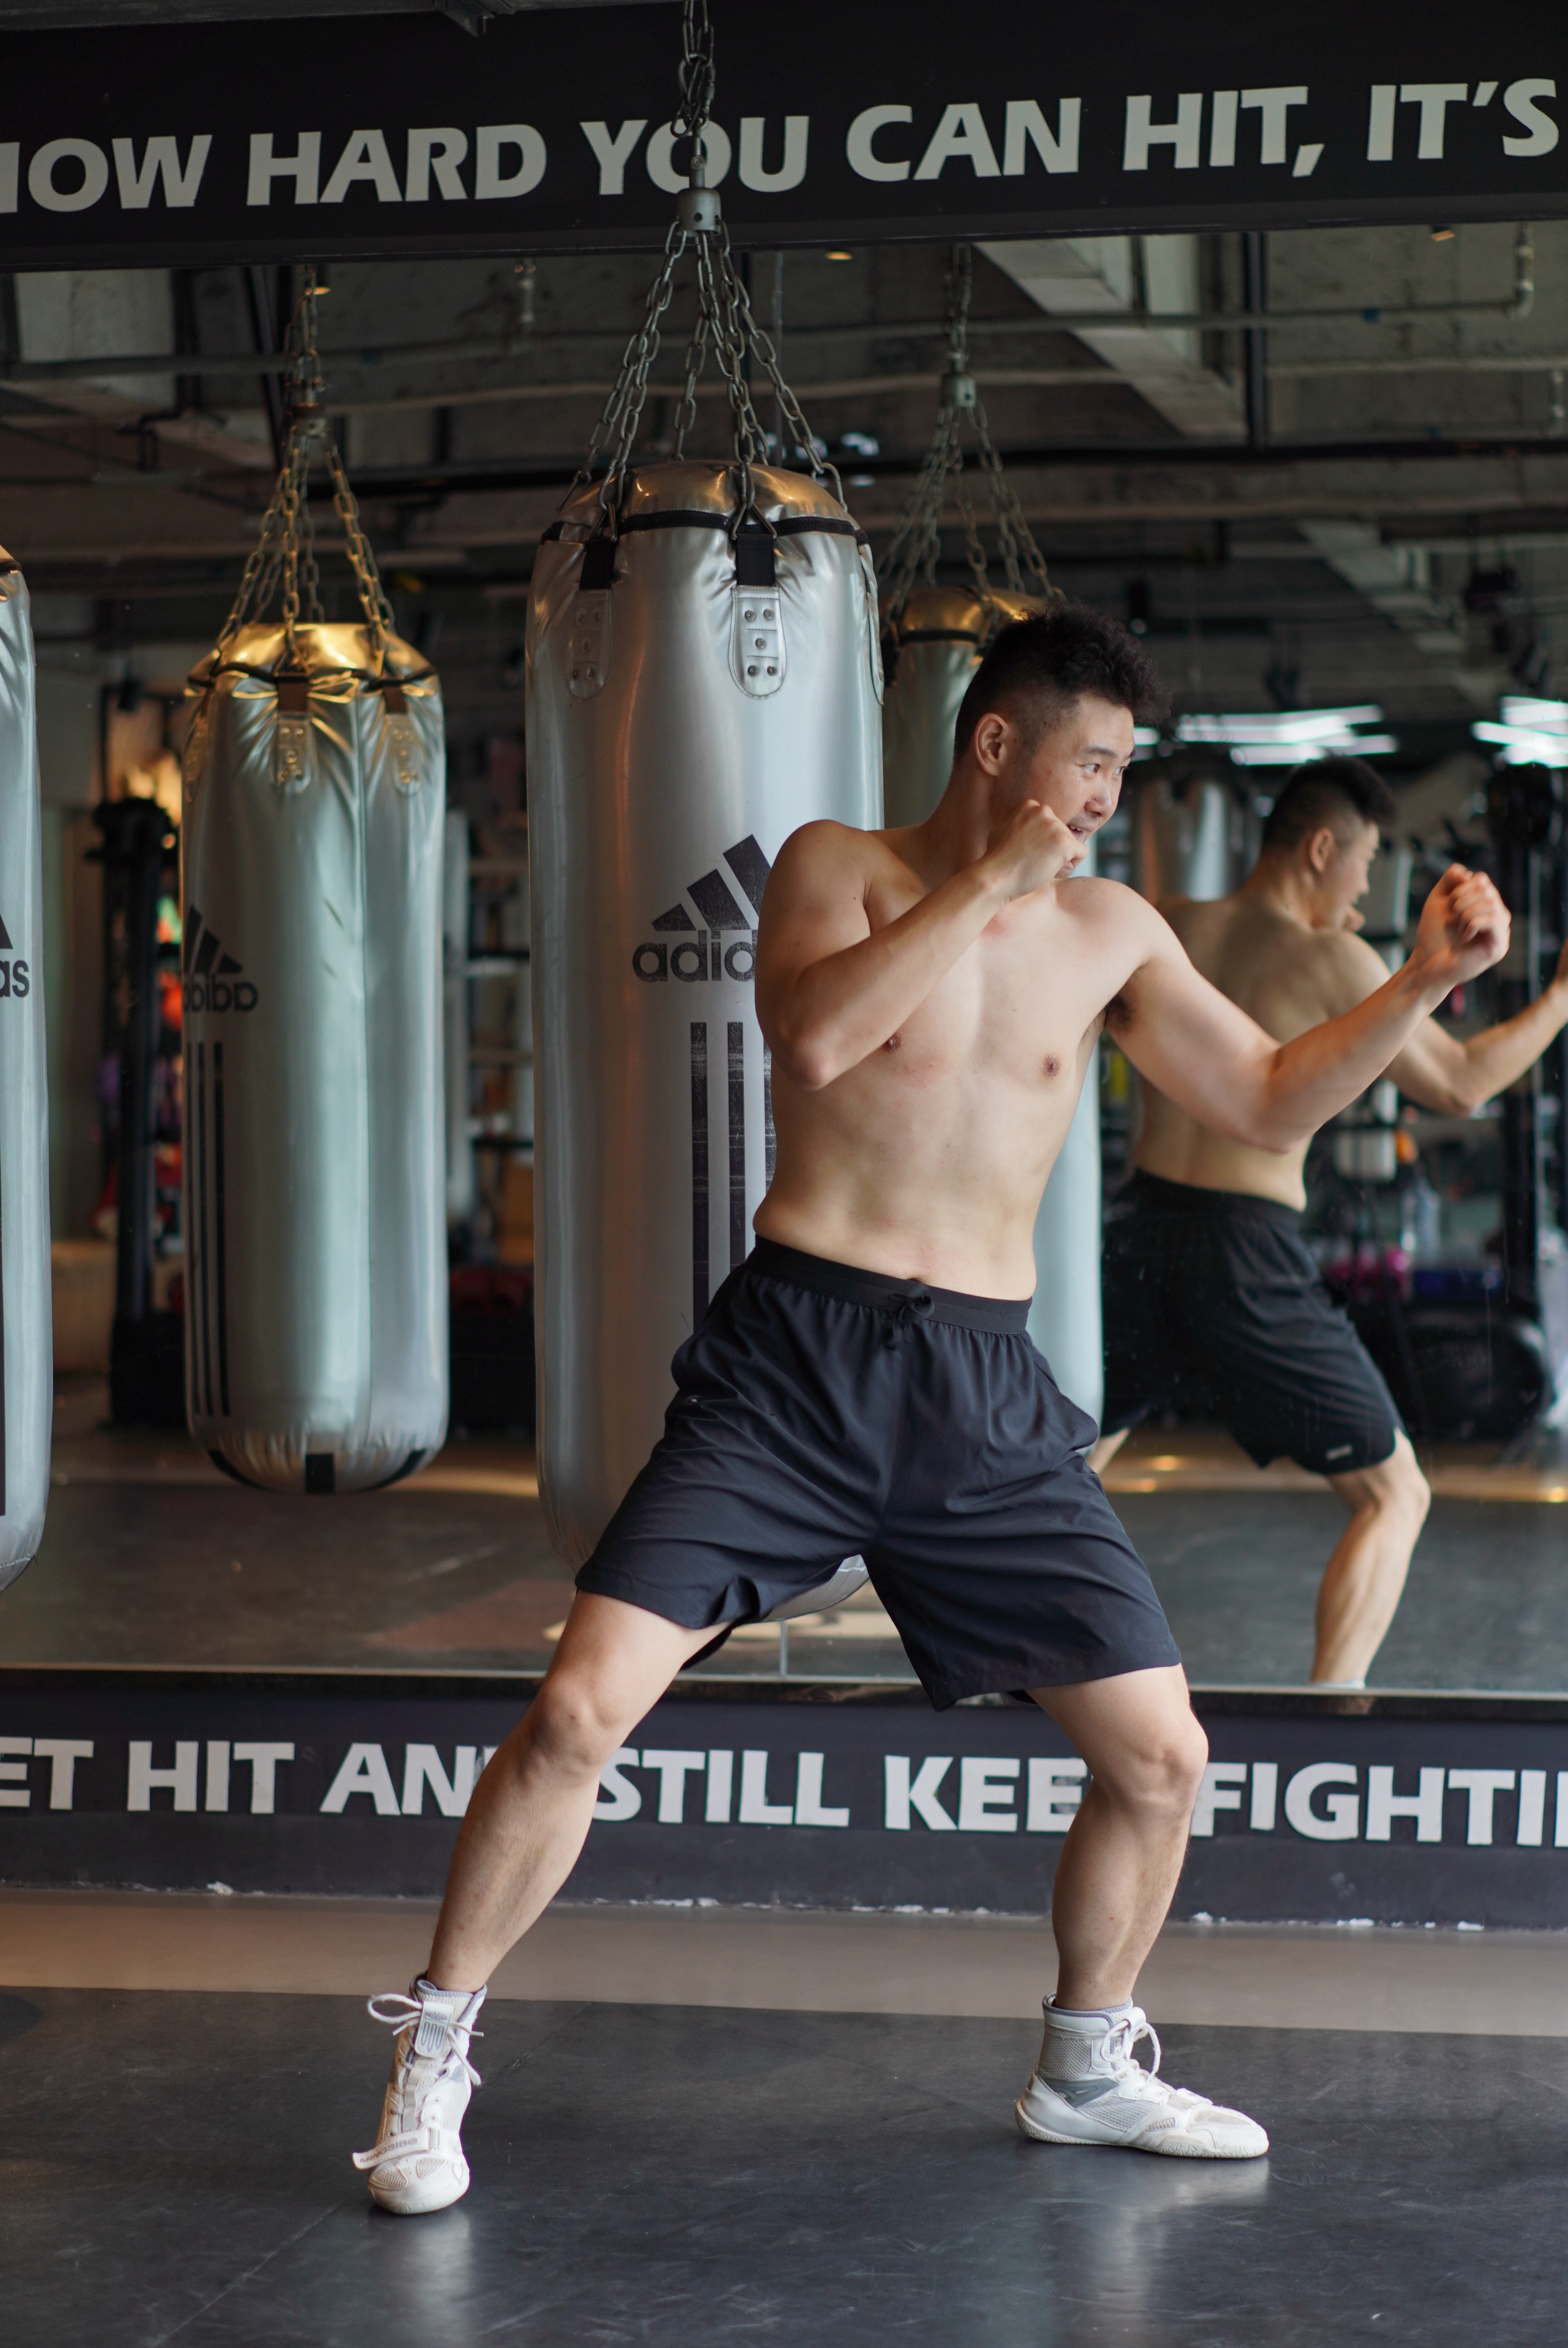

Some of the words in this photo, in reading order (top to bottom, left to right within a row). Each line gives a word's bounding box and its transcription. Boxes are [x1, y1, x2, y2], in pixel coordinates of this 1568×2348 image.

[0, 135, 213, 213] OW
[247, 124, 547, 206] HARD
[580, 115, 810, 195] YOU
[846, 97, 1082, 182] CAN
[1122, 85, 1325, 178] HIT,
[1366, 78, 1560, 161] IT'S
[128, 1741, 295, 1814] HIT
[320, 1743, 498, 1817] AN
[592, 1746, 850, 1827] STILL
[884, 1754, 1094, 1832] KEE
[1190, 1762, 1568, 1847] FIGHTI
